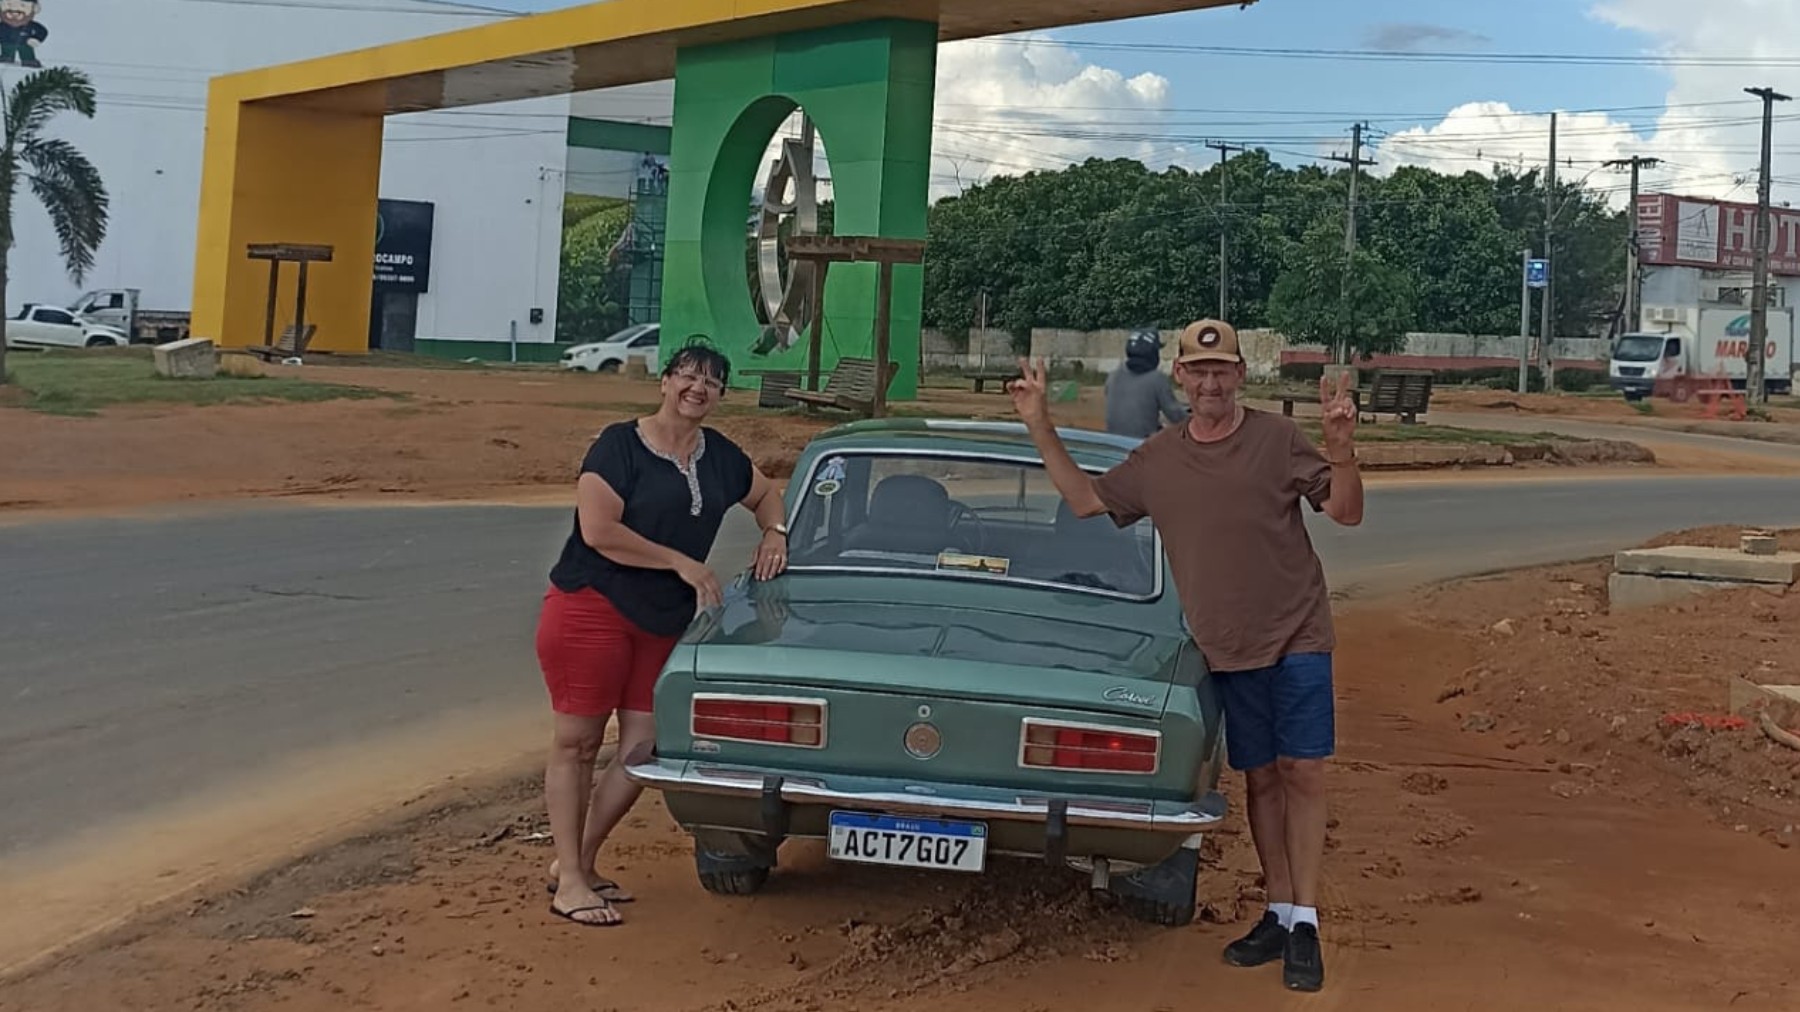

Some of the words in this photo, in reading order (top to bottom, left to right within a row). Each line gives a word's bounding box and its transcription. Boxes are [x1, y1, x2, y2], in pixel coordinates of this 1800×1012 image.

[374, 253, 414, 265] OCAMPO
[1714, 340, 1776, 359] MARO
[844, 829, 969, 866] ACT7G07
